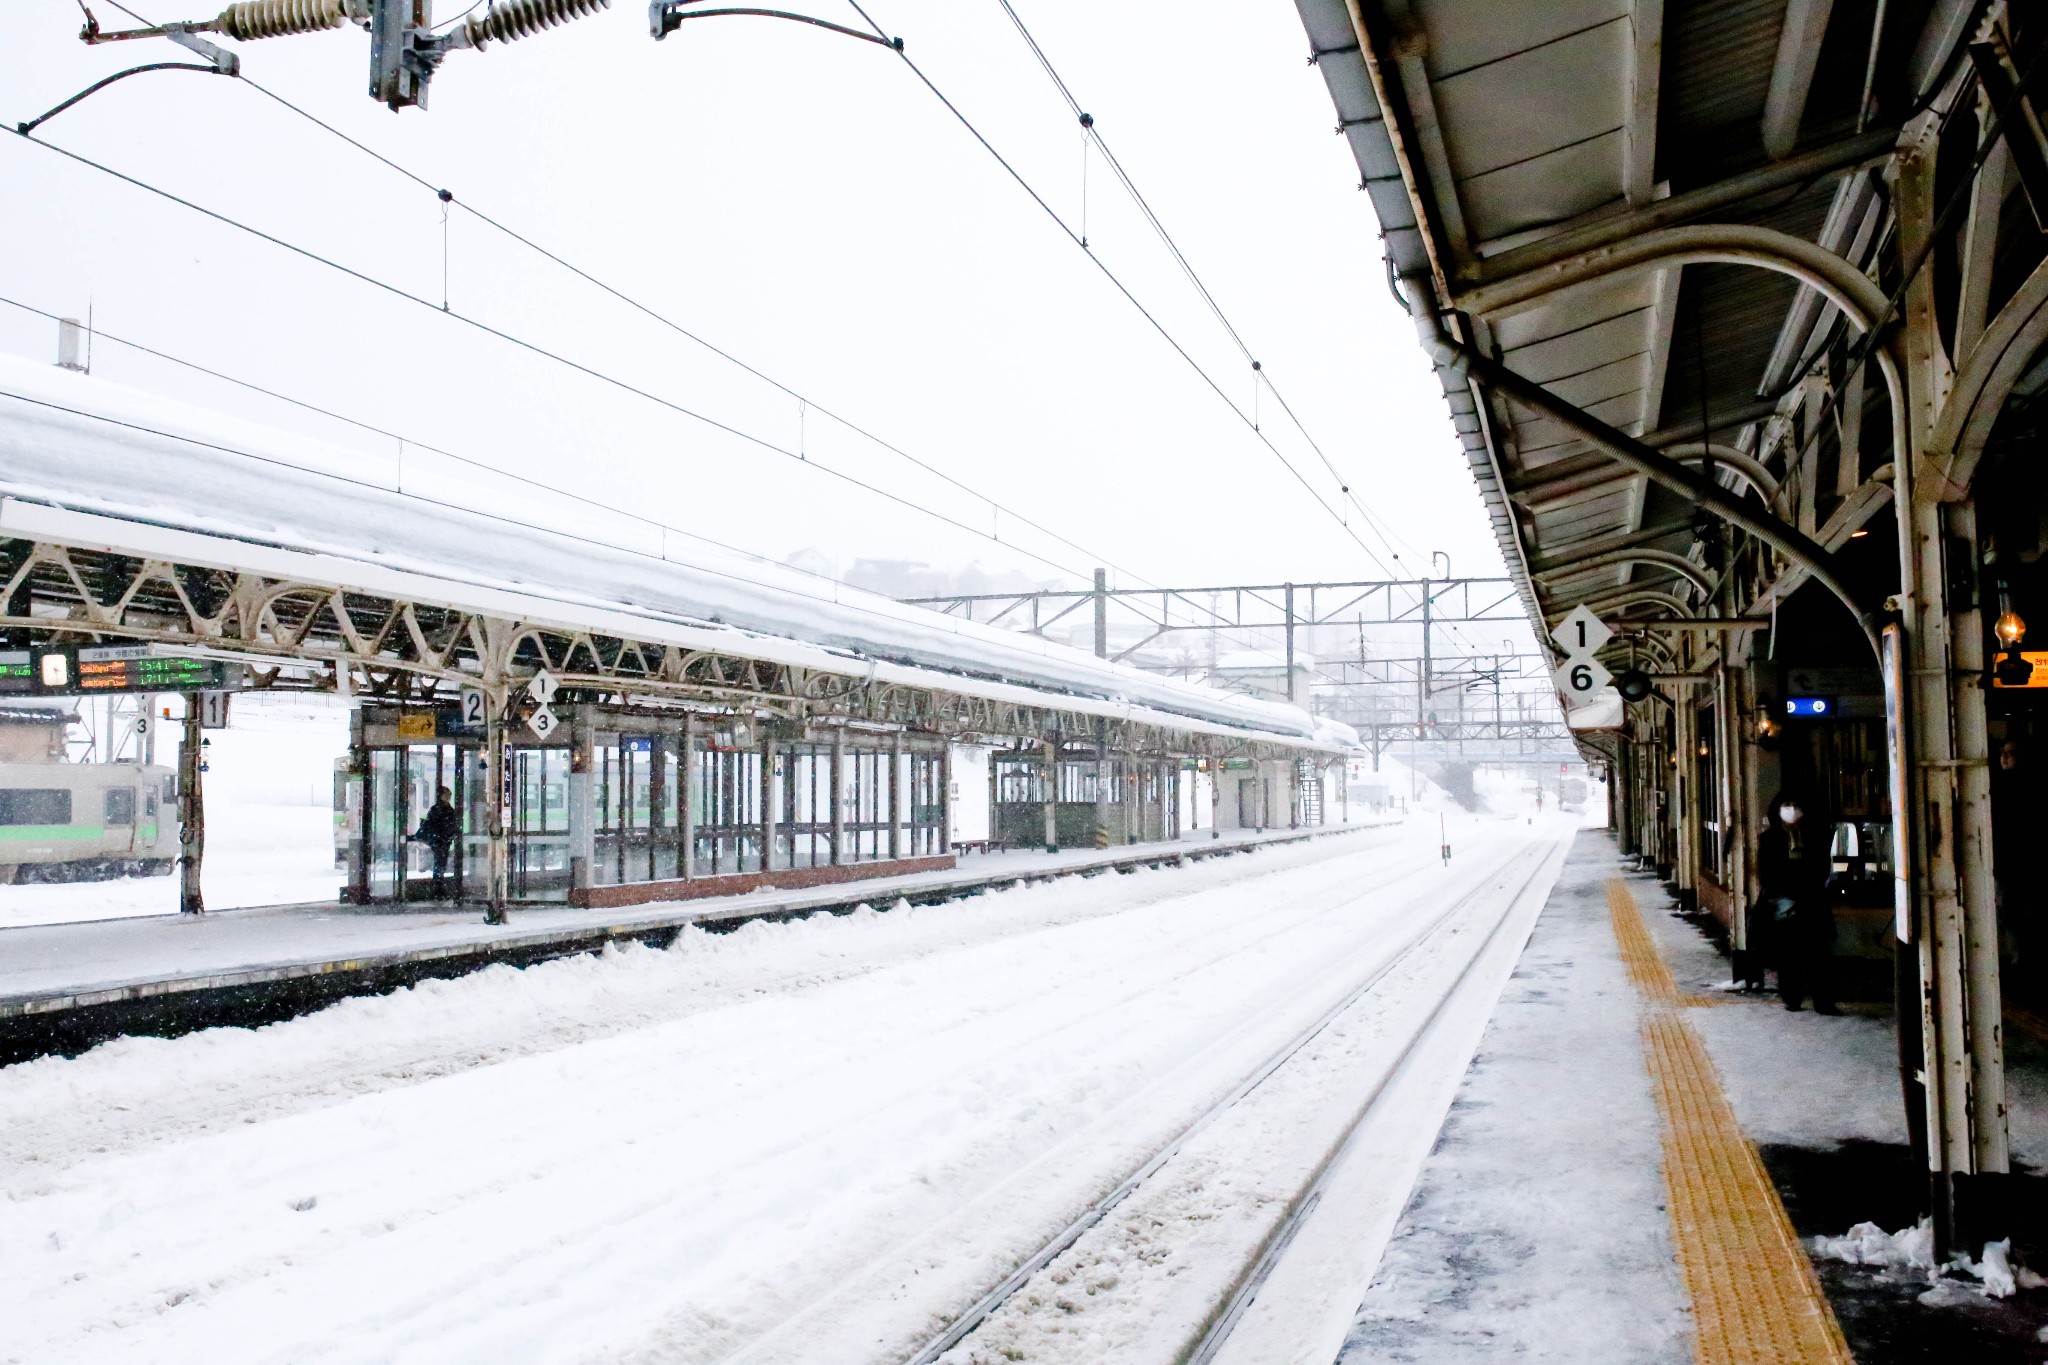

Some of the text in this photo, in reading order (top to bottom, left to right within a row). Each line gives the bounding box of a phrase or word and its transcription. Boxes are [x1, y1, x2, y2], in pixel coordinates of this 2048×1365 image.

[1575, 620, 1586, 648] 1
[539, 678, 545, 694] 1
[1570, 664, 1593, 691] 6
[209, 695, 217, 723] 1
[468, 693, 482, 722] 2
[137, 718, 147, 734] 3
[537, 714, 549, 731] 3
